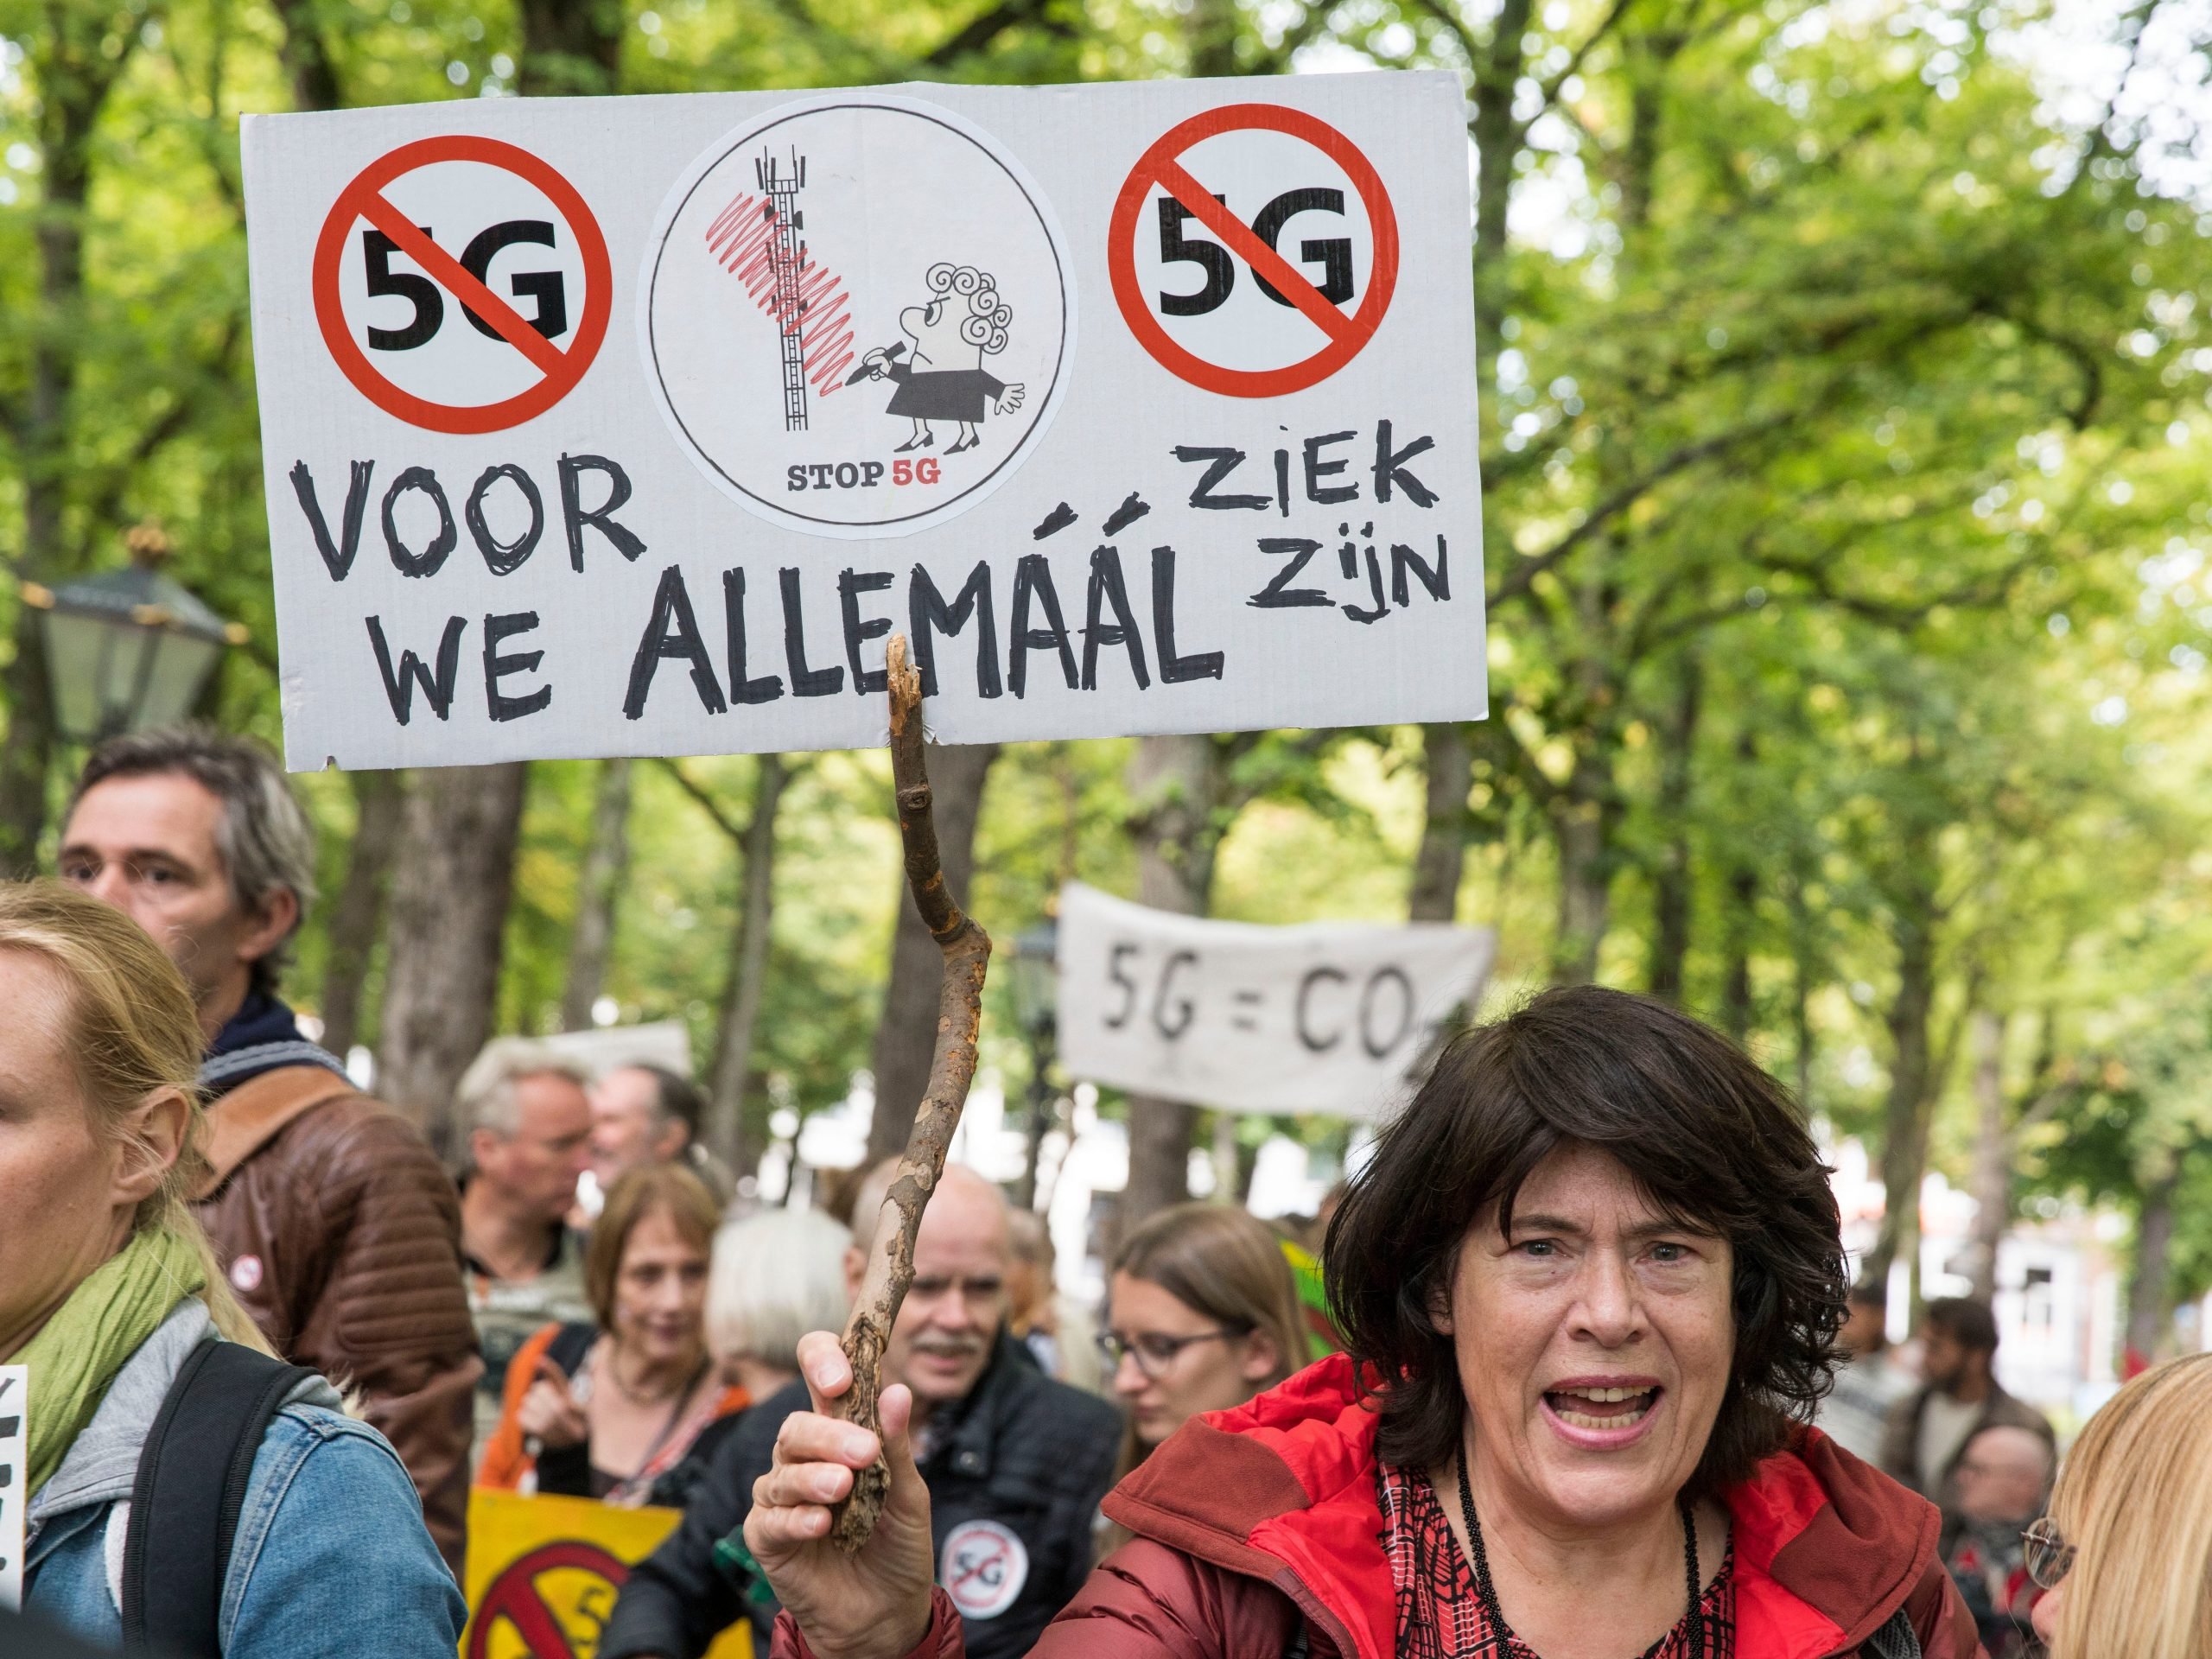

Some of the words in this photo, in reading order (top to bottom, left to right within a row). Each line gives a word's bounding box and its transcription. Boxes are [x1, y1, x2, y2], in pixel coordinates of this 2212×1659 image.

[362, 219, 568, 351] 5G
[1158, 188, 1354, 316] 5G
[289, 453, 647, 582] VOOR
[787, 461, 884, 491] STOP
[893, 458, 941, 486] 5G
[365, 611, 551, 726] WE
[622, 491, 1224, 721] ALLEMÁÁL
[1103, 943, 1198, 1040] 5G
